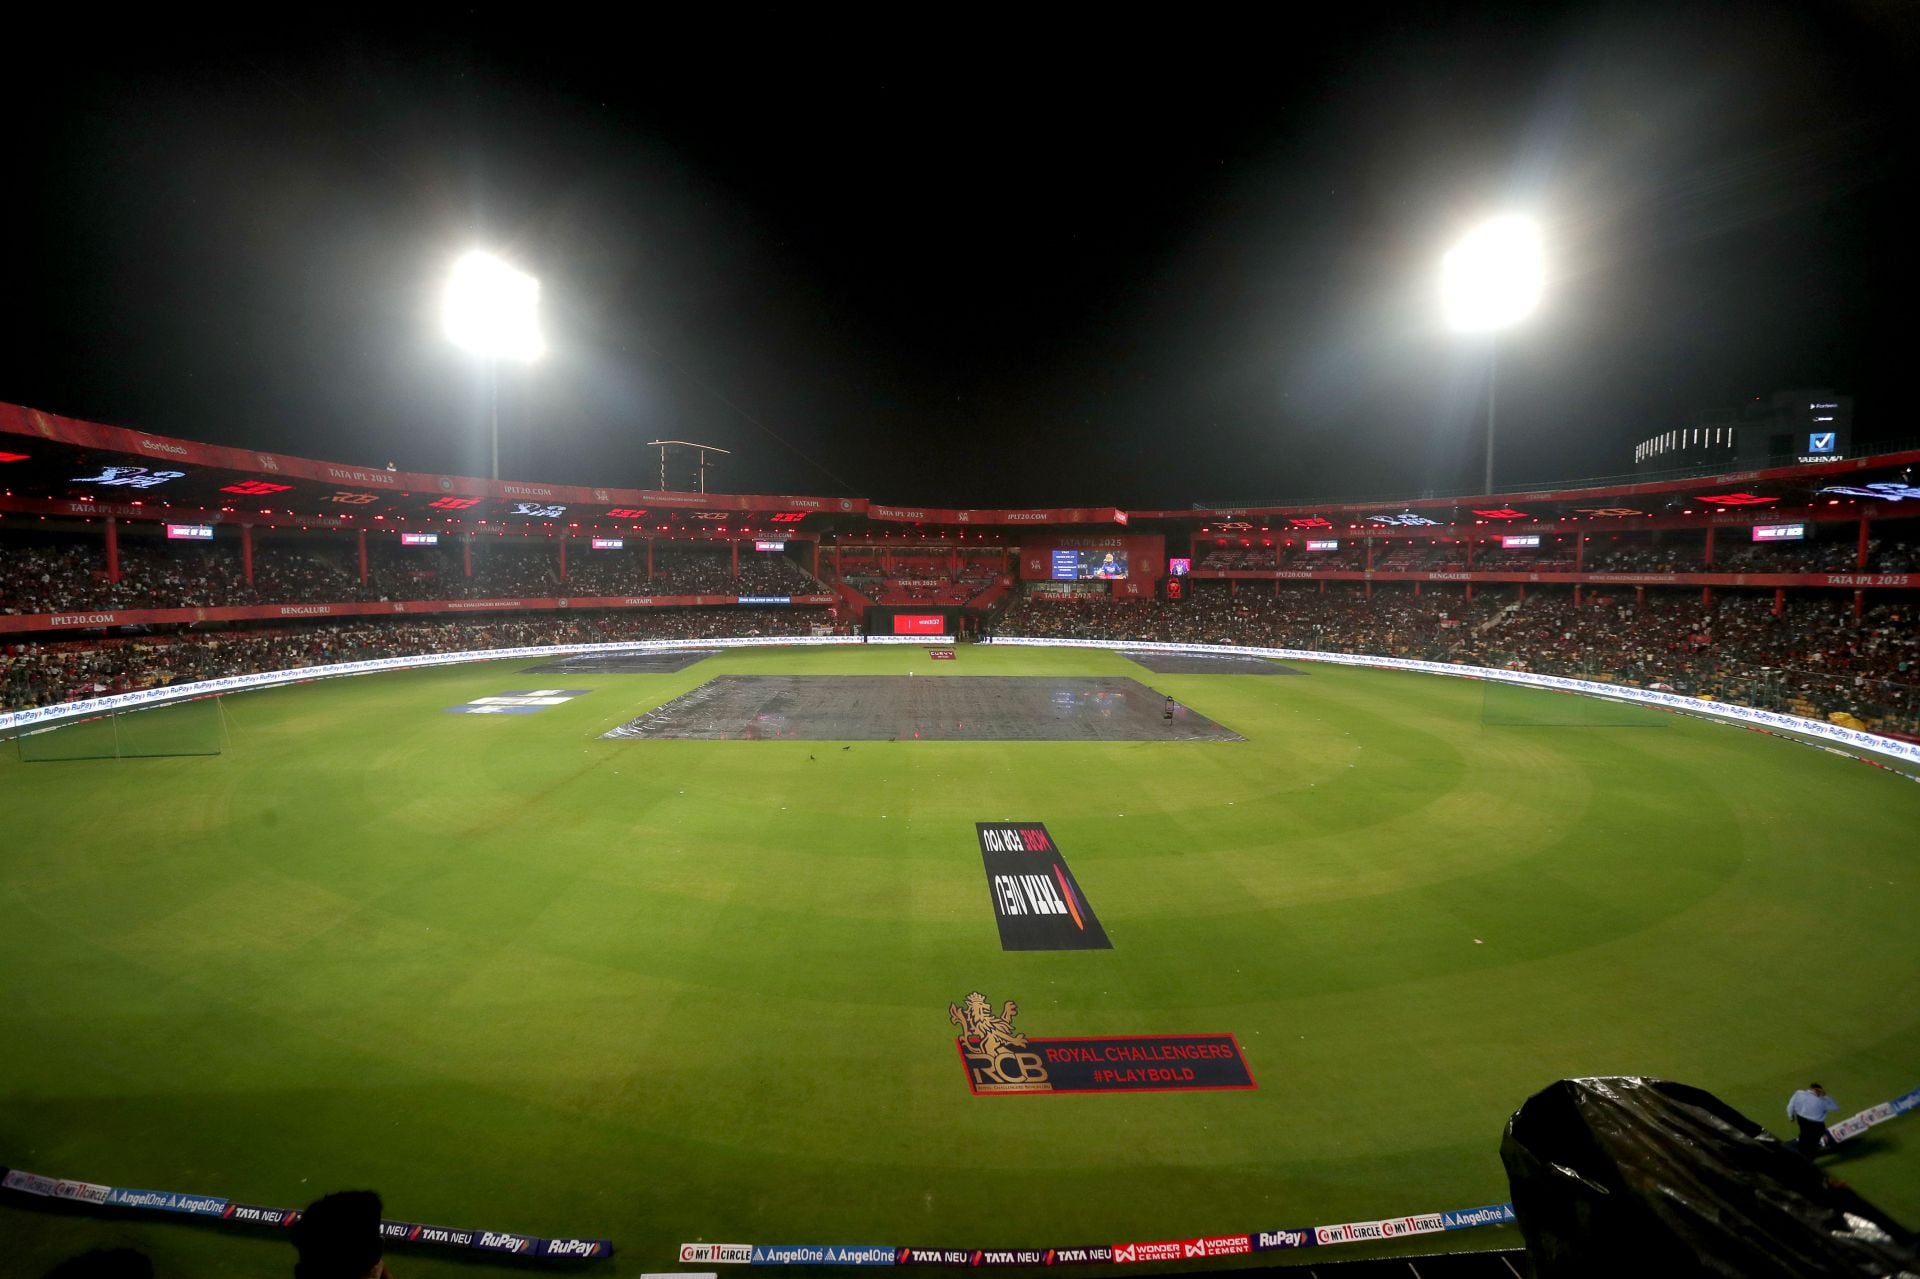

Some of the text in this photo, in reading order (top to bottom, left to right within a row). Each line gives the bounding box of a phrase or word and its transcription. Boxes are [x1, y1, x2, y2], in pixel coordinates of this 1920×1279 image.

[328, 468, 394, 484] TATA IPL 2025
[70, 504, 142, 515] TATA IPL 2025
[1827, 575, 1908, 585] TATA IPL 2025
[281, 606, 330, 615] BENGALURU
[51, 614, 114, 626] IPLT20.COM
[16, 711, 38, 720] RuPay
[44, 707, 67, 715] RuPay
[72, 703, 93, 711] RuPay
[98, 698, 118, 706] RuPay
[122, 694, 142, 702] RuPay
[147, 689, 166, 698] RuPay
[1754, 711, 1773, 722] RuPay
[1778, 716, 1798, 727] RuPay
[1803, 721, 1825, 734] RuPay
[1829, 726, 1850, 739] RuPay
[1854, 733, 1876, 746] RuPay
[1880, 740, 1905, 754] RuPay
[983, 829, 1052, 851] MORE FOR YOU
[995, 875, 1068, 915] TATA NEU
[1047, 1044, 1233, 1063] ROYAL CHALLENGERS
[966, 1052, 1049, 1084] RCB
[1093, 1067, 1195, 1083] #PLAYBOLD
[235, 1207, 282, 1222] TATA NEU
[386, 1225, 407, 1236] NEU
[422, 1229, 472, 1245] TATA NEU
[480, 1232, 524, 1253] RuPay
[1205, 1237, 1248, 1248] WONDER
[1259, 1231, 1301, 1248] RuPay
[548, 1240, 594, 1257] RuPay
[1057, 1249, 1112, 1261] TATA NEU
[1136, 1244, 1180, 1253] WONDER
[1208, 1246, 1249, 1255] CEMENT
[912, 1251, 967, 1263] TATA NEU
[984, 1251, 1040, 1263] TATA NEU
[1138, 1252, 1181, 1261] CEMENT
